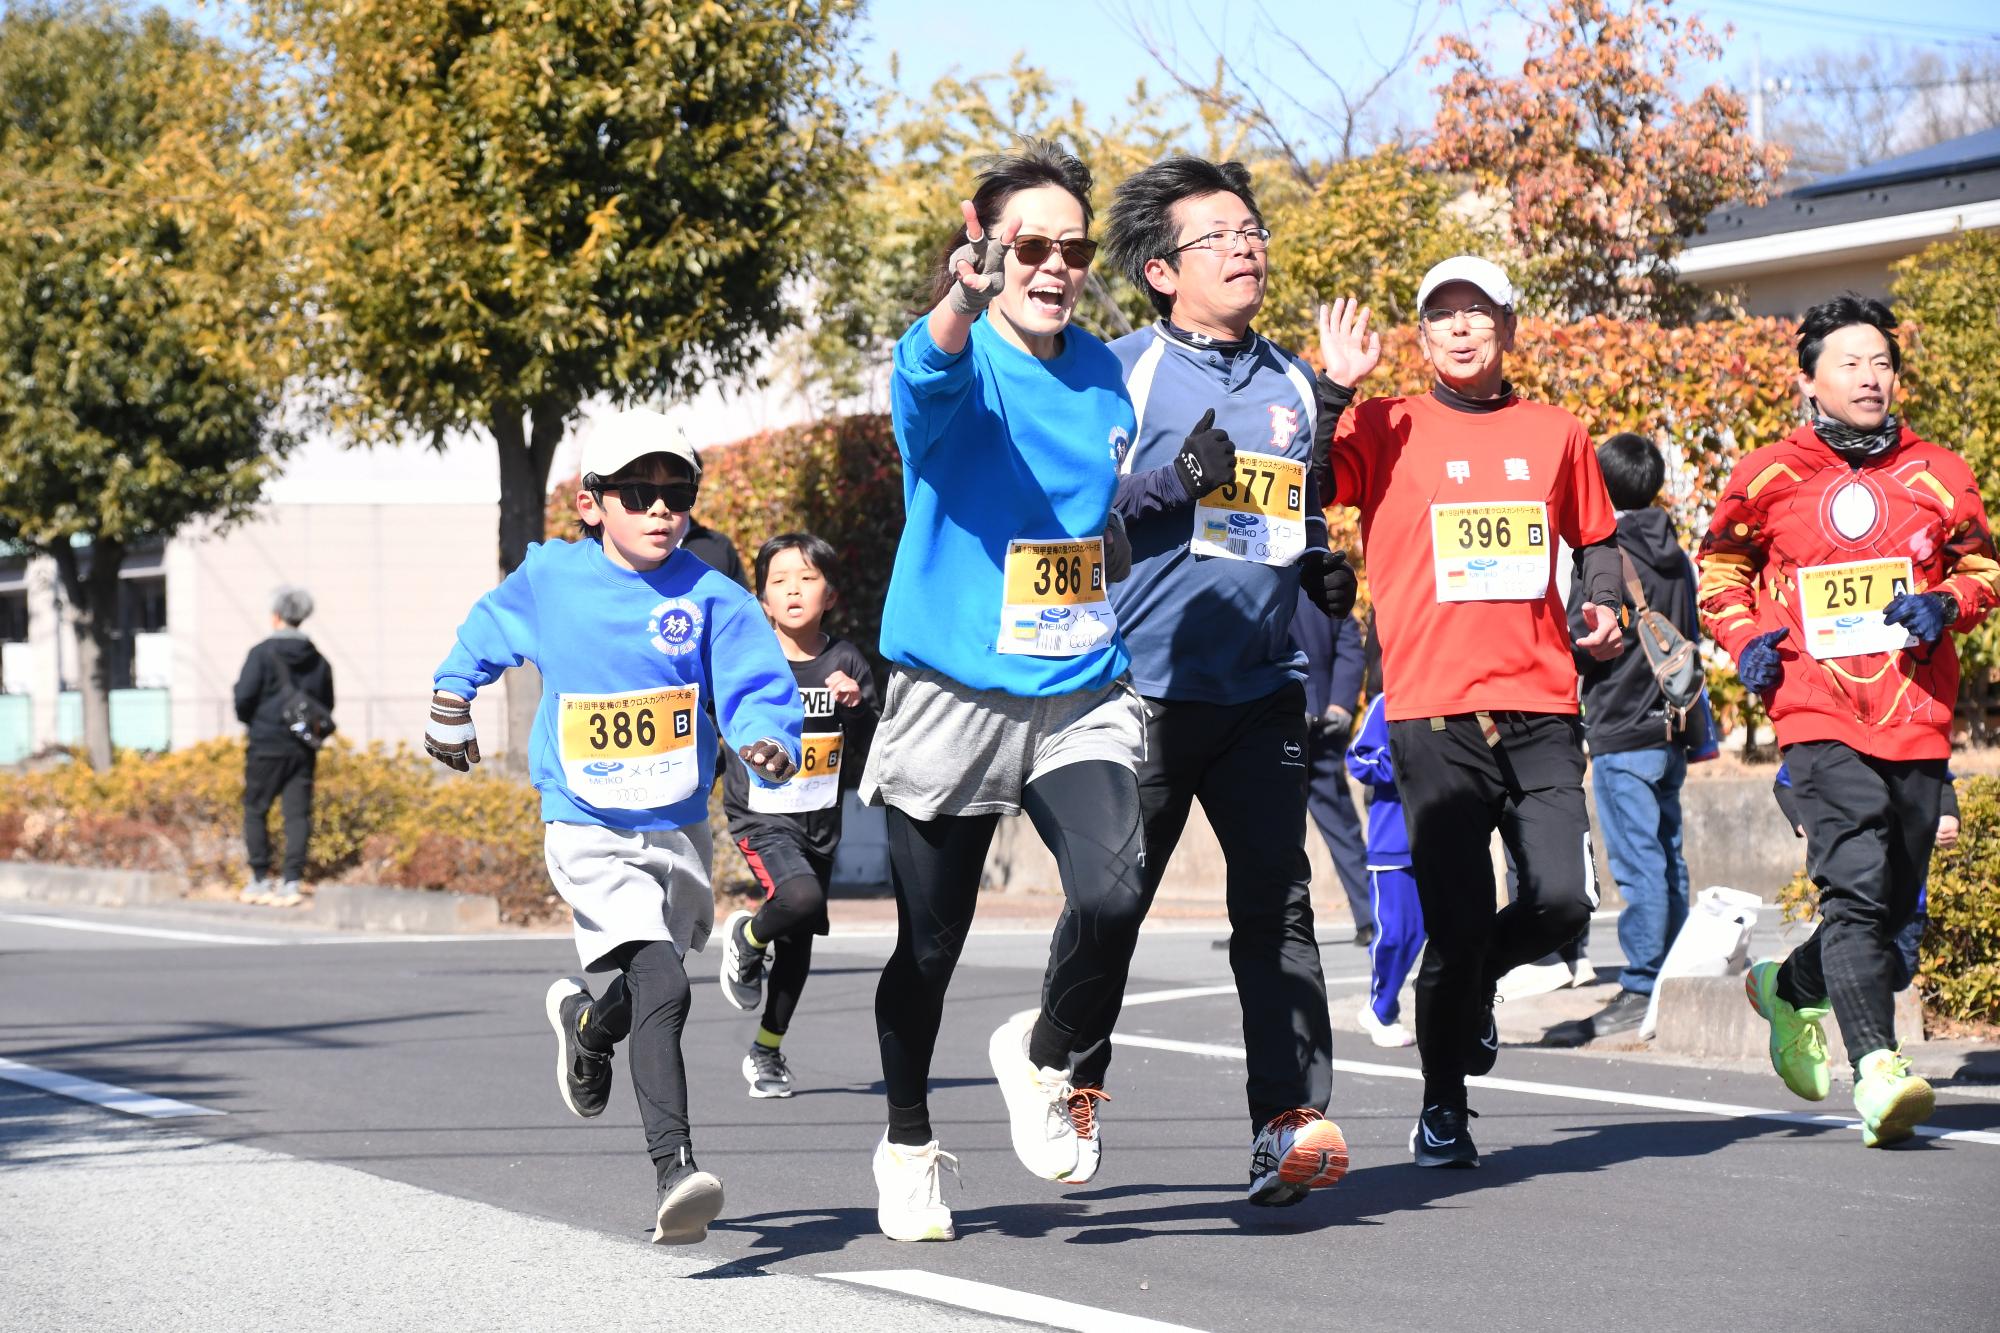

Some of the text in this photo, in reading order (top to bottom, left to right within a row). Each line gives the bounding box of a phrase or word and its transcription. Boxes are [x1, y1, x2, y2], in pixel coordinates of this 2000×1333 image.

[1181, 453, 1201, 487] OAKLEY
[1236, 457, 1303, 476] 梅の里クロスカントリー大会
[1446, 460, 1470, 484] 甲
[1289, 488, 1299, 508] B
[1228, 527, 1257, 538] MEIKO
[1260, 523, 1302, 538] メイコー
[1458, 517, 1542, 549] 396 B
[1034, 556, 1100, 595] 386 B
[1824, 575, 1907, 609] 257 A
[1072, 610, 1111, 625] メイコー
[1038, 623, 1070, 632] MEIKO
[589, 708, 688, 750] 386 B
[829, 751, 838, 766] B
[629, 760, 682, 778] メイコー
[589, 776, 623, 785] MEIKO
